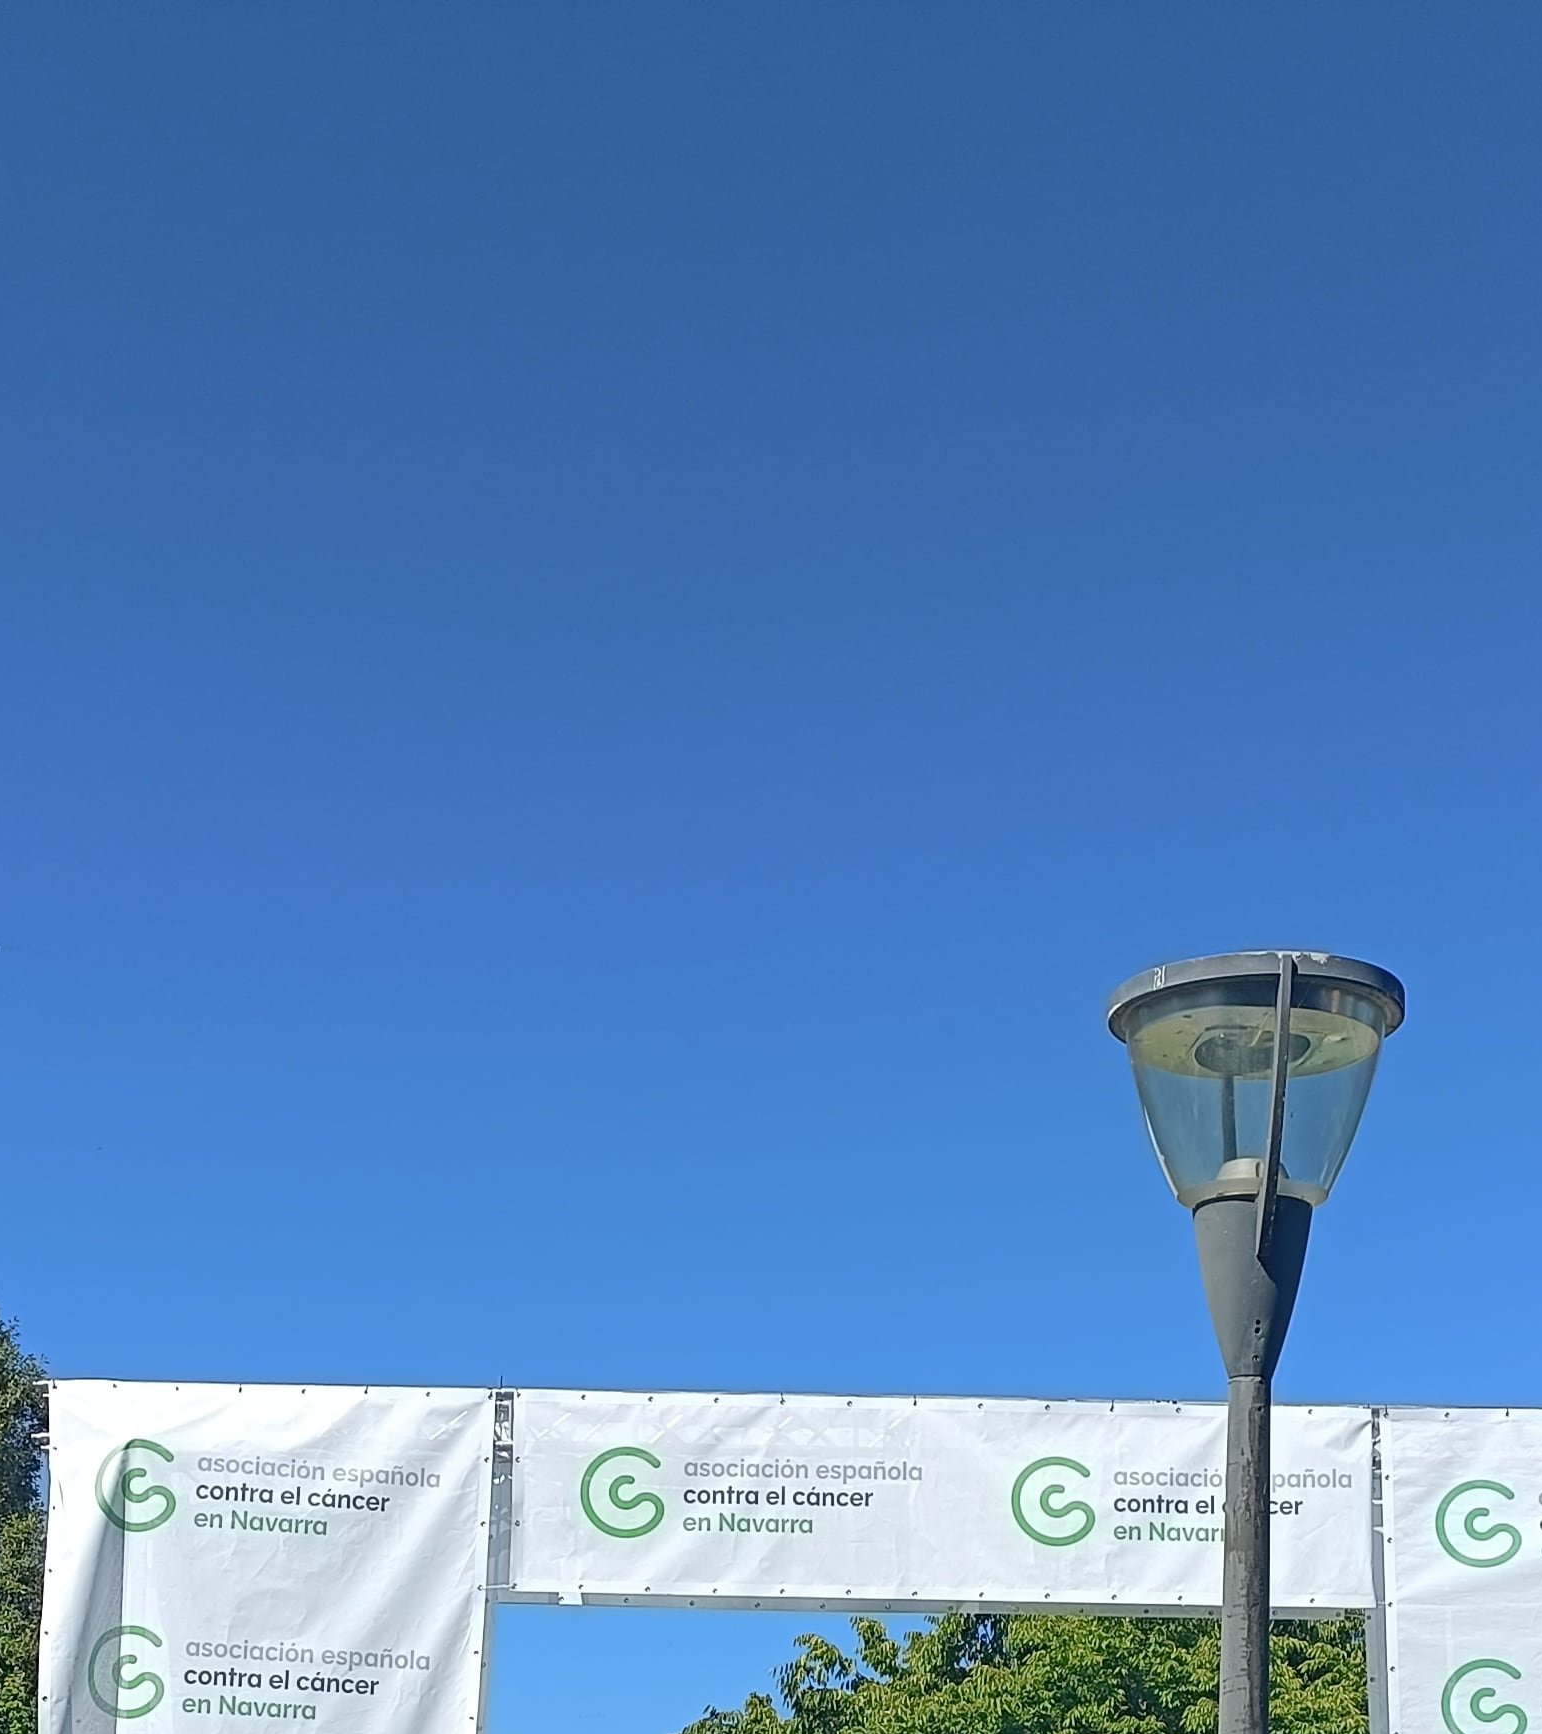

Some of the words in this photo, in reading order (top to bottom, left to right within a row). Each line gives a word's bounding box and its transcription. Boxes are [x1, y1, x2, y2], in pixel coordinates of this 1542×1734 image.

[196, 1454, 326, 1482] asociación
[332, 1464, 441, 1490] española
[683, 1458, 810, 1481] asociación
[815, 1460, 924, 1486] española
[1113, 1467, 1223, 1488] asociació
[1272, 1468, 1352, 1494] pañola
[195, 1481, 274, 1506] contra
[280, 1484, 301, 1507] el
[307, 1486, 390, 1513] cáncer
[682, 1484, 761, 1507] contra
[766, 1484, 787, 1507] el
[792, 1484, 874, 1509] cáncer
[1114, 1495, 1189, 1514] contra
[1195, 1495, 1215, 1515] el
[194, 1512, 224, 1529] en
[230, 1511, 328, 1537] Navarra
[682, 1515, 712, 1533] en
[718, 1512, 814, 1536] Navarra
[1113, 1524, 1141, 1541] en
[185, 1638, 314, 1665] asociación
[321, 1647, 431, 1672] española
[183, 1665, 262, 1689] contra
[268, 1668, 290, 1691] el
[296, 1669, 380, 1696] cáncer
[182, 1697, 212, 1714] en
[218, 1694, 316, 1721] Navarra
